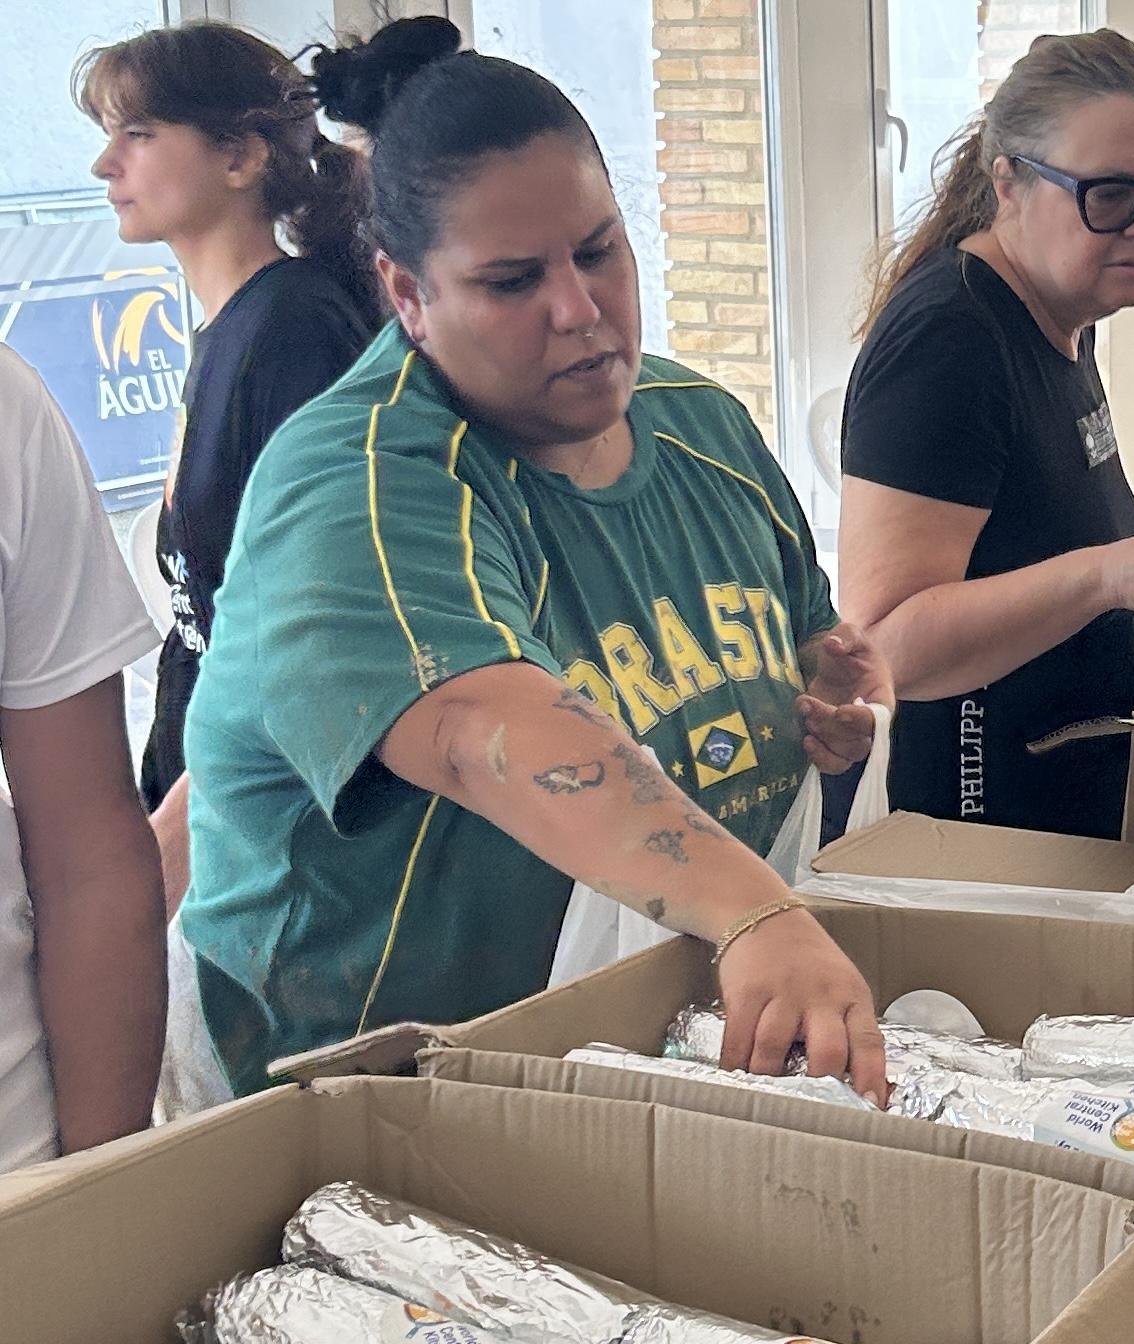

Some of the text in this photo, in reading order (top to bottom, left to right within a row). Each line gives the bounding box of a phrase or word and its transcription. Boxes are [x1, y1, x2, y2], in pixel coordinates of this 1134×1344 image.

[147, 349, 172, 370] EL
[960, 699, 985, 817] PHILIPP
[1064, 1100, 1111, 1123] Central
[1072, 1091, 1120, 1112] Kitchen
[1066, 1112, 1104, 1134] World
